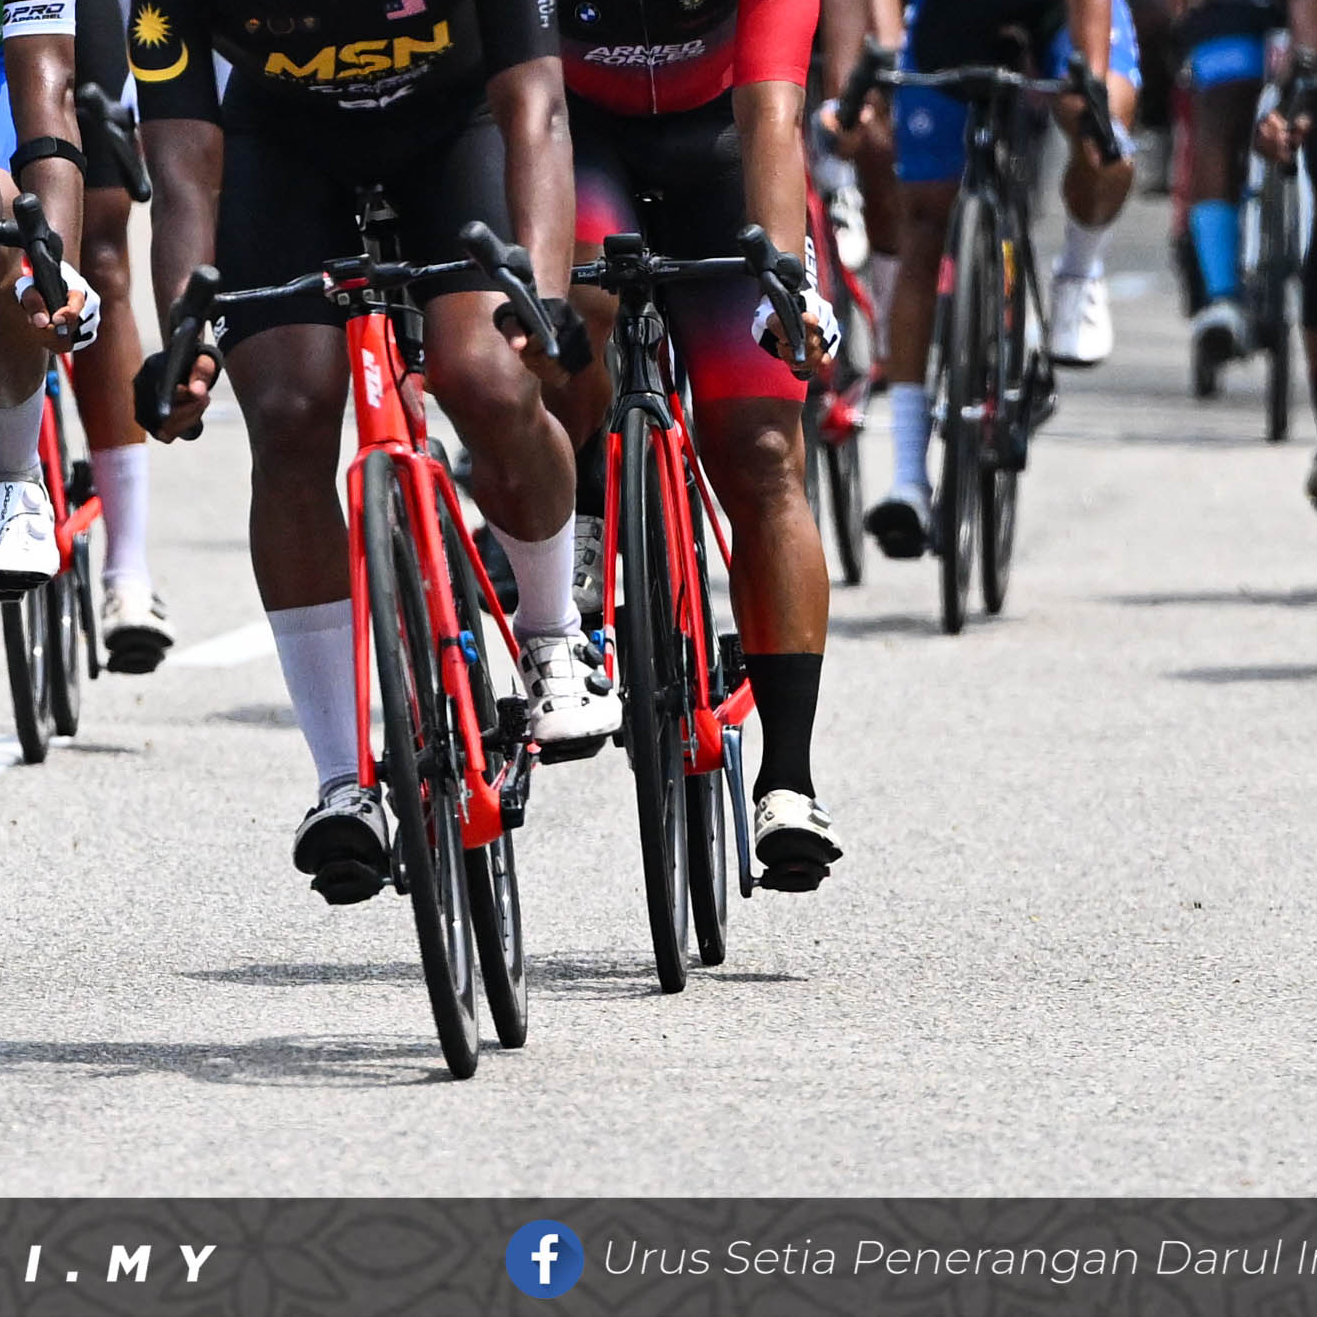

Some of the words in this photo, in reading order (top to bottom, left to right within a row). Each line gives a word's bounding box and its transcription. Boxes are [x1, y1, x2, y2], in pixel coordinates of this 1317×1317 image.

[12, 3, 66, 18] PRO
[264, 20, 450, 81] MSN
[587, 39, 704, 57] ARMED
